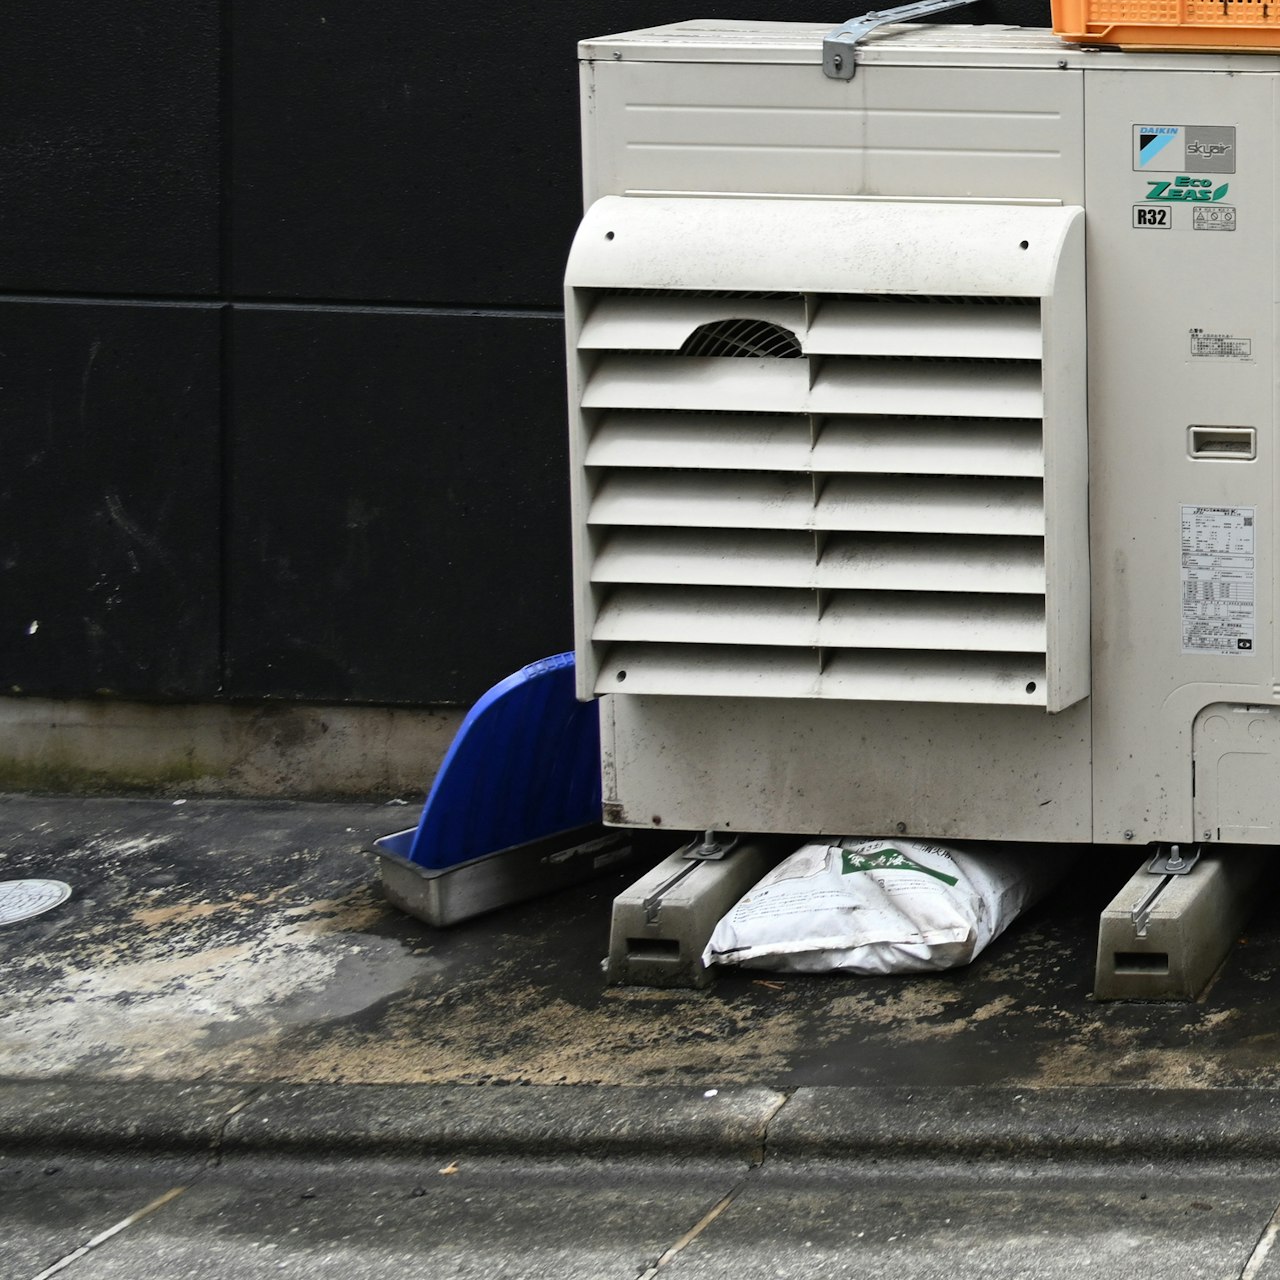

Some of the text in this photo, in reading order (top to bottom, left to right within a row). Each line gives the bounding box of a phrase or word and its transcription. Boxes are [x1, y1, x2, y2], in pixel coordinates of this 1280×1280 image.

[1139, 126, 1179, 135] DAIKIN
[1186, 139, 1232, 159] skyair
[1137, 208, 1167, 226] R32
